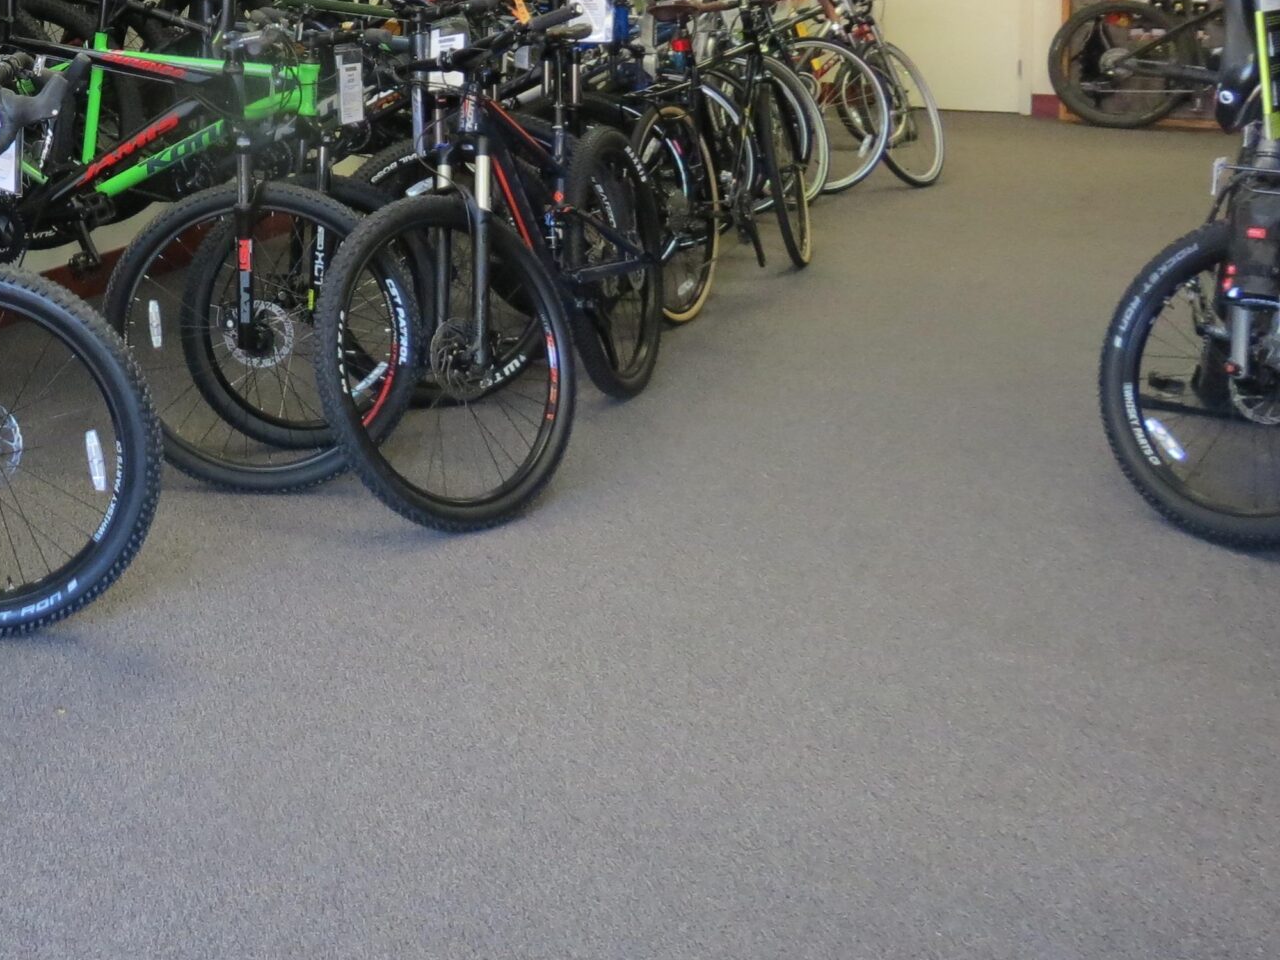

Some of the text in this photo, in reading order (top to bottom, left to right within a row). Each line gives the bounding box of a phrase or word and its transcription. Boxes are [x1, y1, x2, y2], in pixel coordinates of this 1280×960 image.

[385, 278, 410, 366] CST PATROL
[1122, 389, 1141, 431] WHISKY
[1131, 425, 1155, 458] PARTS
[20, 591, 62, 618] RON
